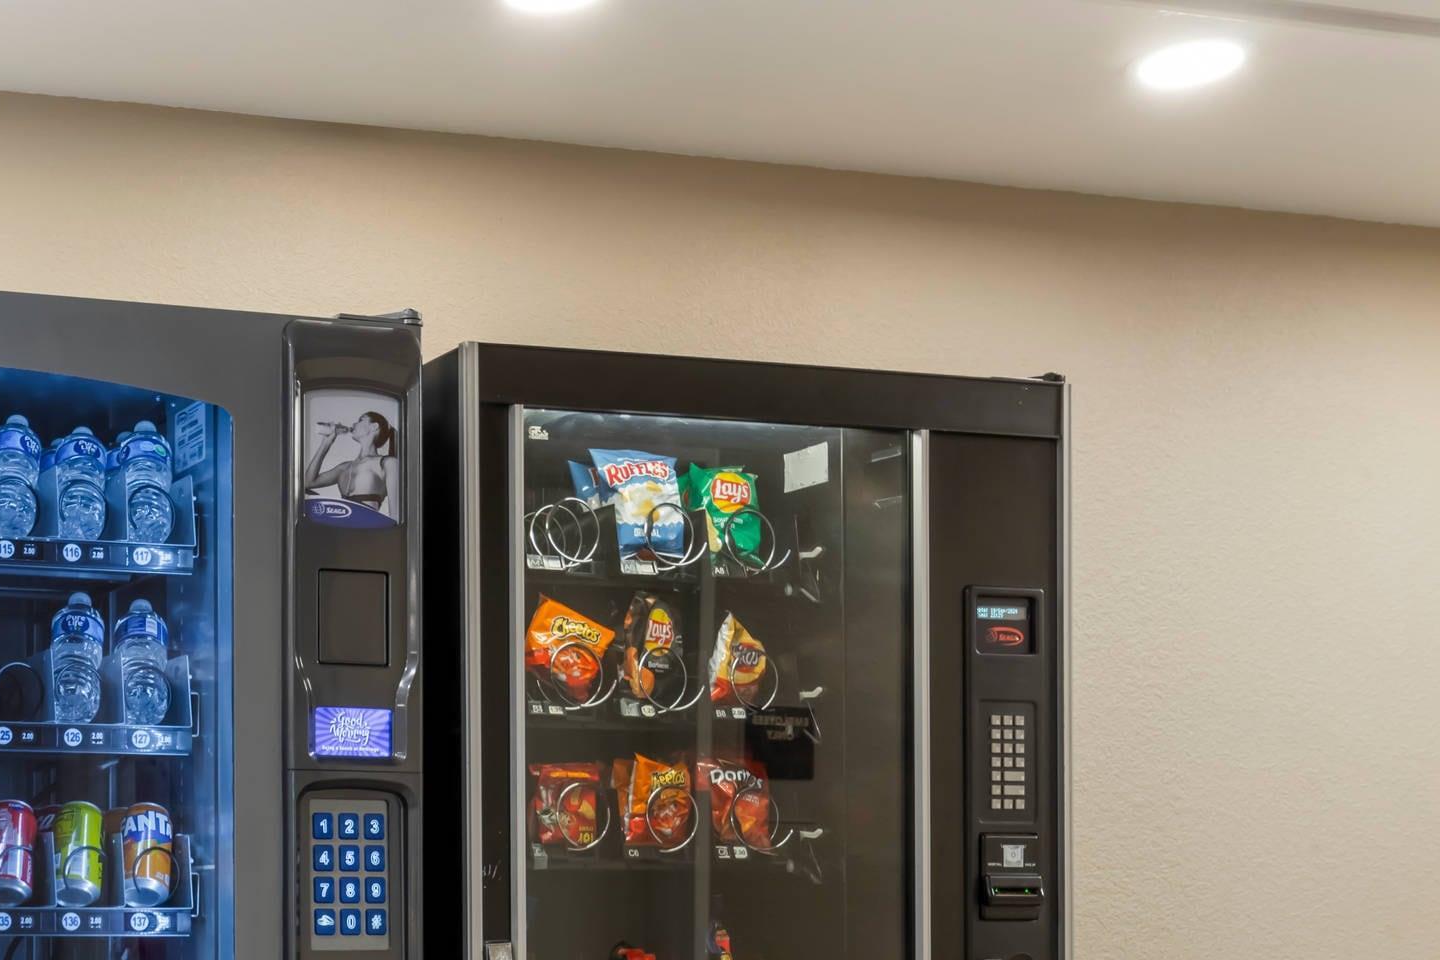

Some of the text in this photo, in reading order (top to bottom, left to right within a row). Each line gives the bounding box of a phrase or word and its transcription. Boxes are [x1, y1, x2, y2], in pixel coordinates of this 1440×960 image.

[604, 459, 670, 487] RUFFLES
[715, 479, 748, 503] Lay's
[63, 546, 104, 559] 116 2.00
[134, 550, 150, 562] 117
[65, 614, 86, 622] Pure
[67, 619, 84, 628] Life
[550, 616, 601, 643] Cheetos
[337, 711, 363, 728] Good
[22, 732, 34, 740] 2.00
[65, 731, 81, 743] 126
[133, 734, 148, 745] 127
[329, 724, 370, 746] Morning
[710, 768, 763, 789] Doritos
[319, 818, 380, 834] 1 2 3
[319, 850, 380, 865] 4 5 6
[319, 882, 381, 898] 7 8 9
[20, 916, 32, 924] 2.00
[63, 916, 79, 927] 136
[132, 916, 147, 927] 137
[346, 914, 382, 929] 0 #
